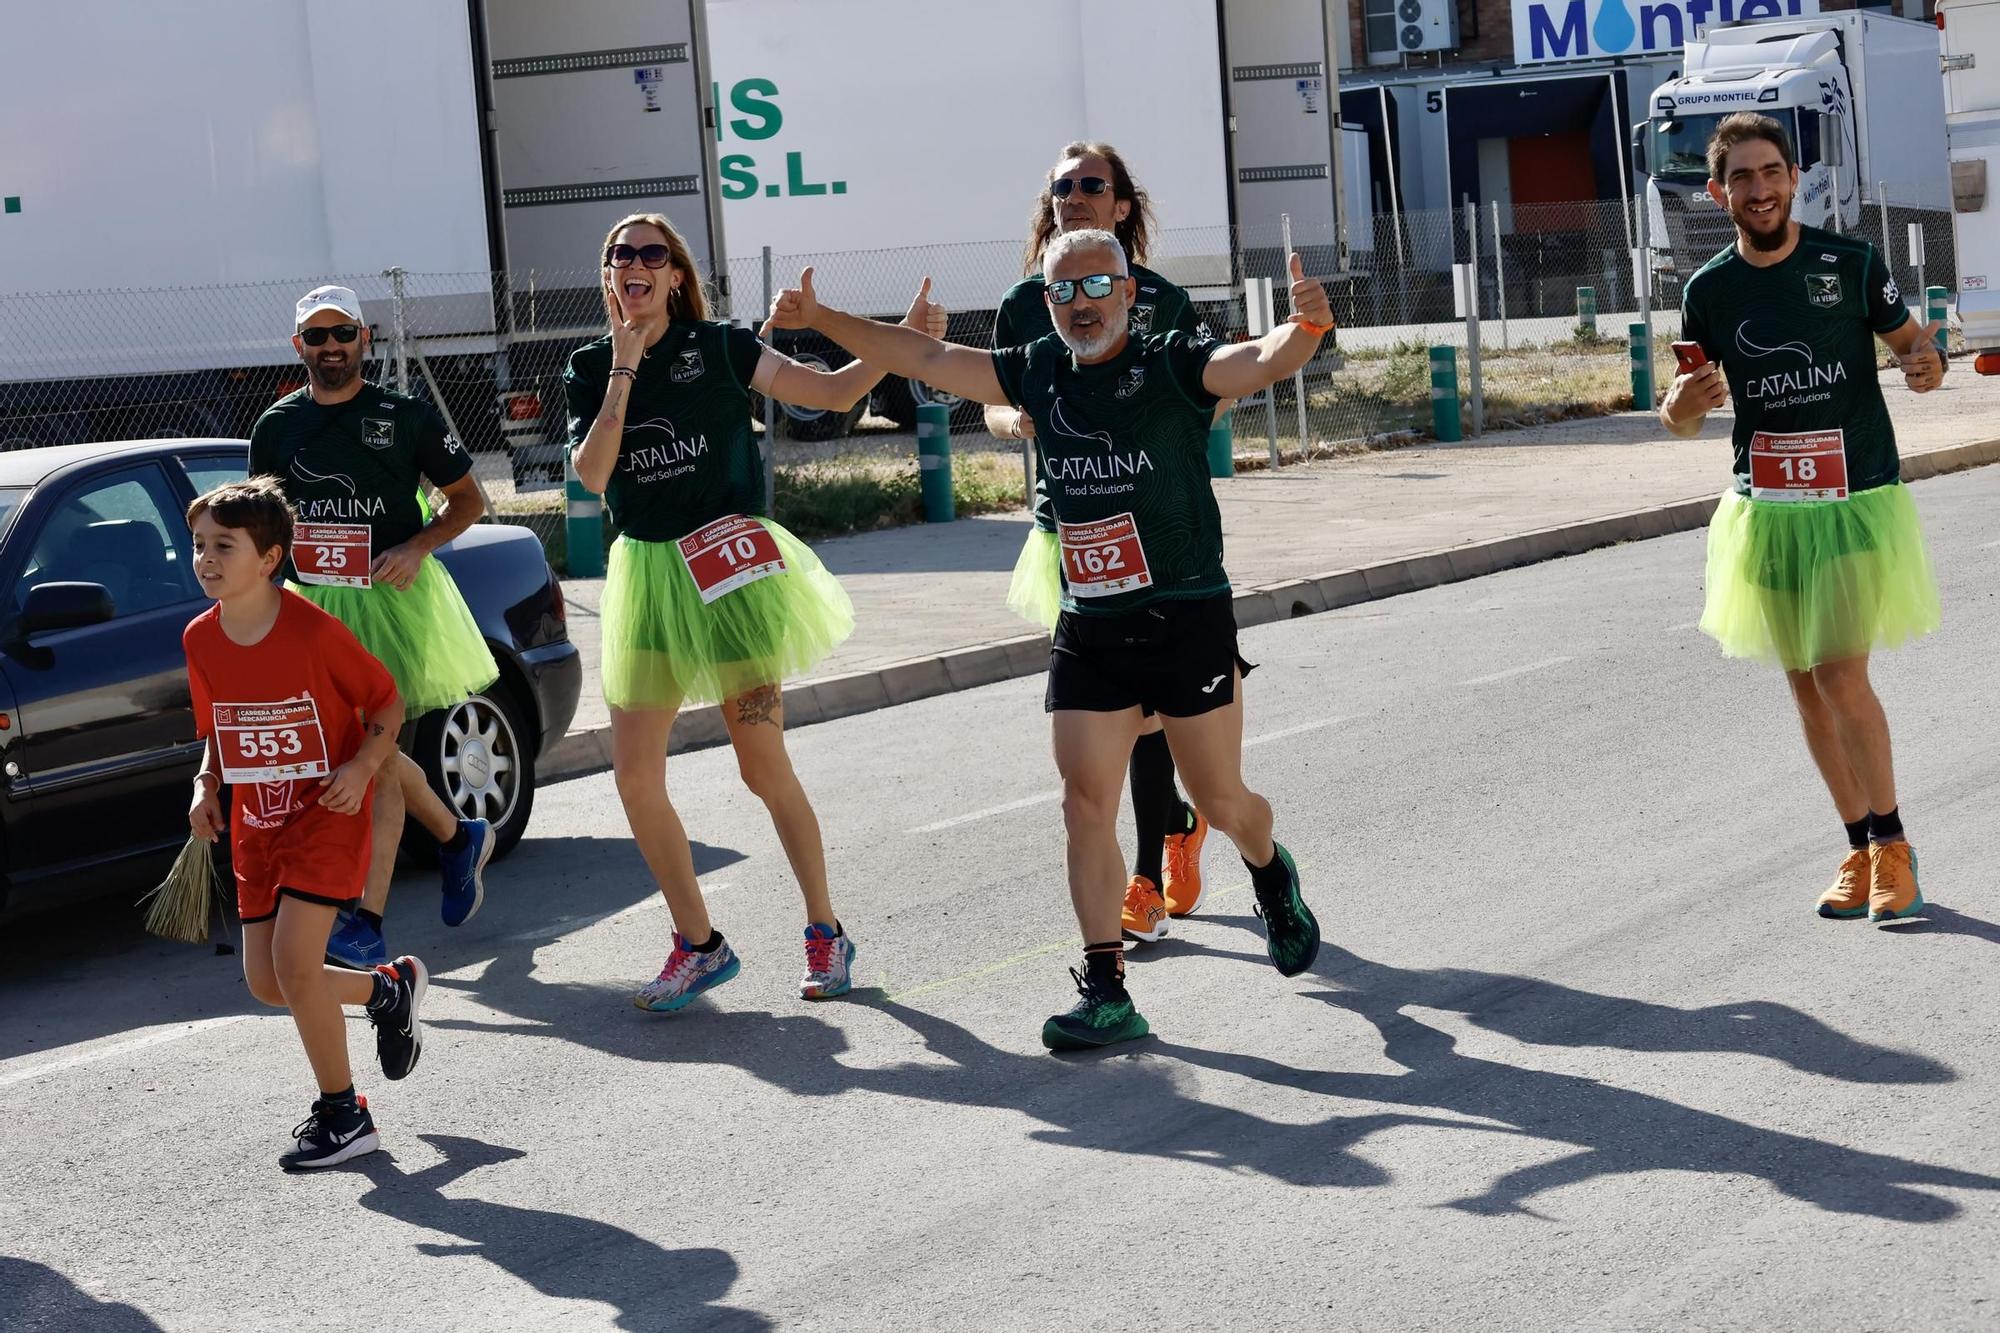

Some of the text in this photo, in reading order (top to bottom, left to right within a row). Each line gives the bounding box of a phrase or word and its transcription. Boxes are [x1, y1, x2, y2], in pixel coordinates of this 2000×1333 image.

[1426, 91, 1442, 113] 5
[1678, 92, 1756, 105] GRUPO MONTIEL
[1813, 292, 1838, 303] LA VERDE
[674, 372, 682, 380] LA
[1747, 361, 1847, 398] CATALINA
[1764, 391, 1831, 411] Food Solutions
[365, 436, 390, 445] LA VERDE
[1804, 435, 1839, 444] SOLIDARIA
[637, 464, 696, 484] Food Solutions
[1047, 450, 1154, 480] CATALINA
[1779, 457, 1817, 481] 18
[1065, 482, 1134, 496] Food Solutions
[705, 521, 734, 537] CARRERA
[1094, 519, 1130, 533] SOLIDARIA
[315, 546, 347, 568] 25
[718, 536, 757, 566] 10
[1072, 545, 1125, 575] 162
[238, 714, 287, 723] MERCAMURCIA
[240, 709, 271, 717] CARRERA
[271, 705, 311, 715] SOLIDARIA
[239, 729, 303, 758] 553
